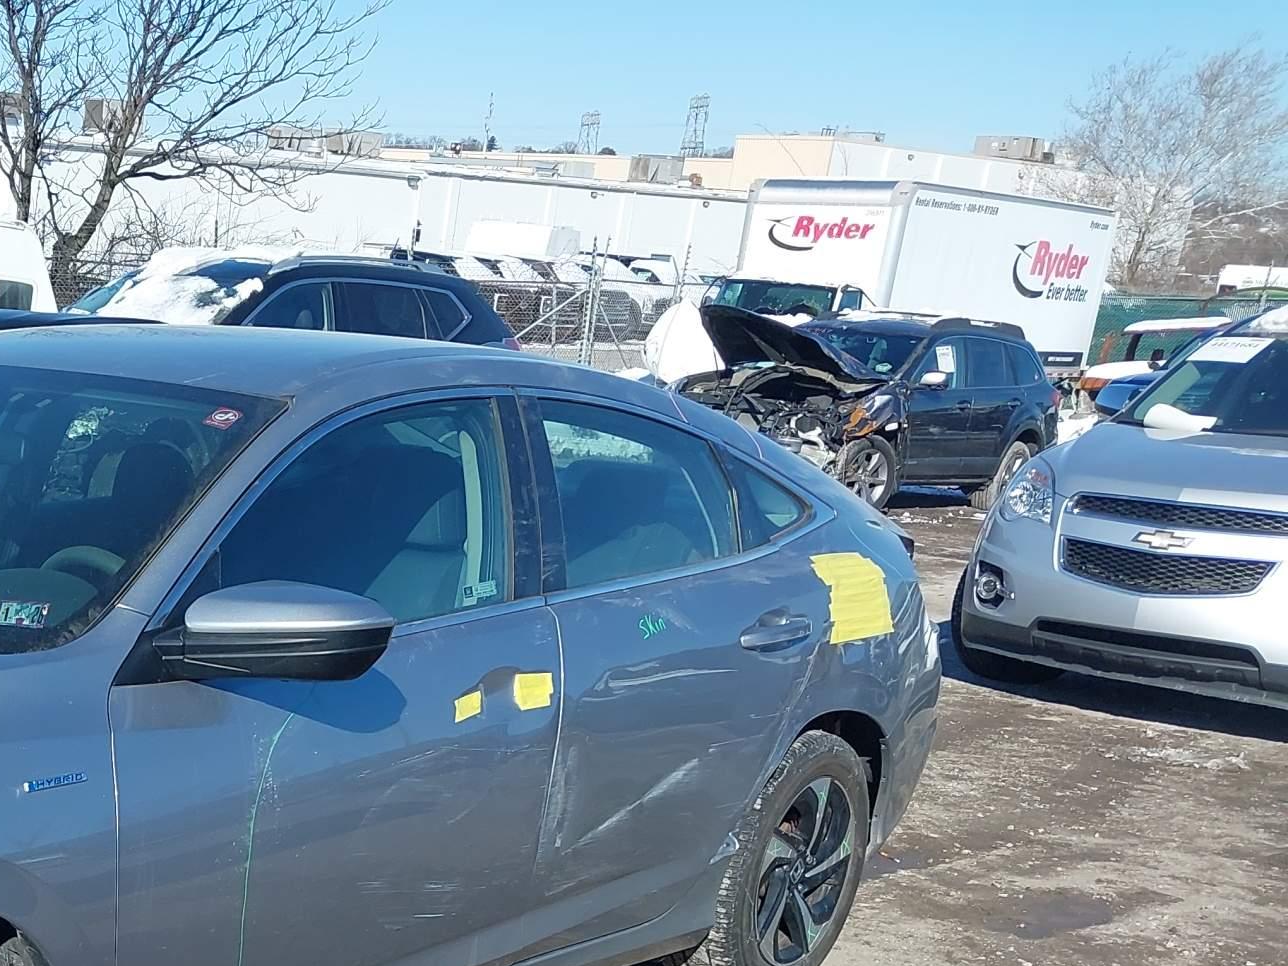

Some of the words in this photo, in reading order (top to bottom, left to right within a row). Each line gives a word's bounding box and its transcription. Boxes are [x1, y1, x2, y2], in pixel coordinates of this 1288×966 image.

[792, 215, 875, 243] Ryder
[1030, 240, 1089, 285] Ryder
[1046, 282, 1065, 300] Ever
[36, 773, 84, 789] HYBRID
